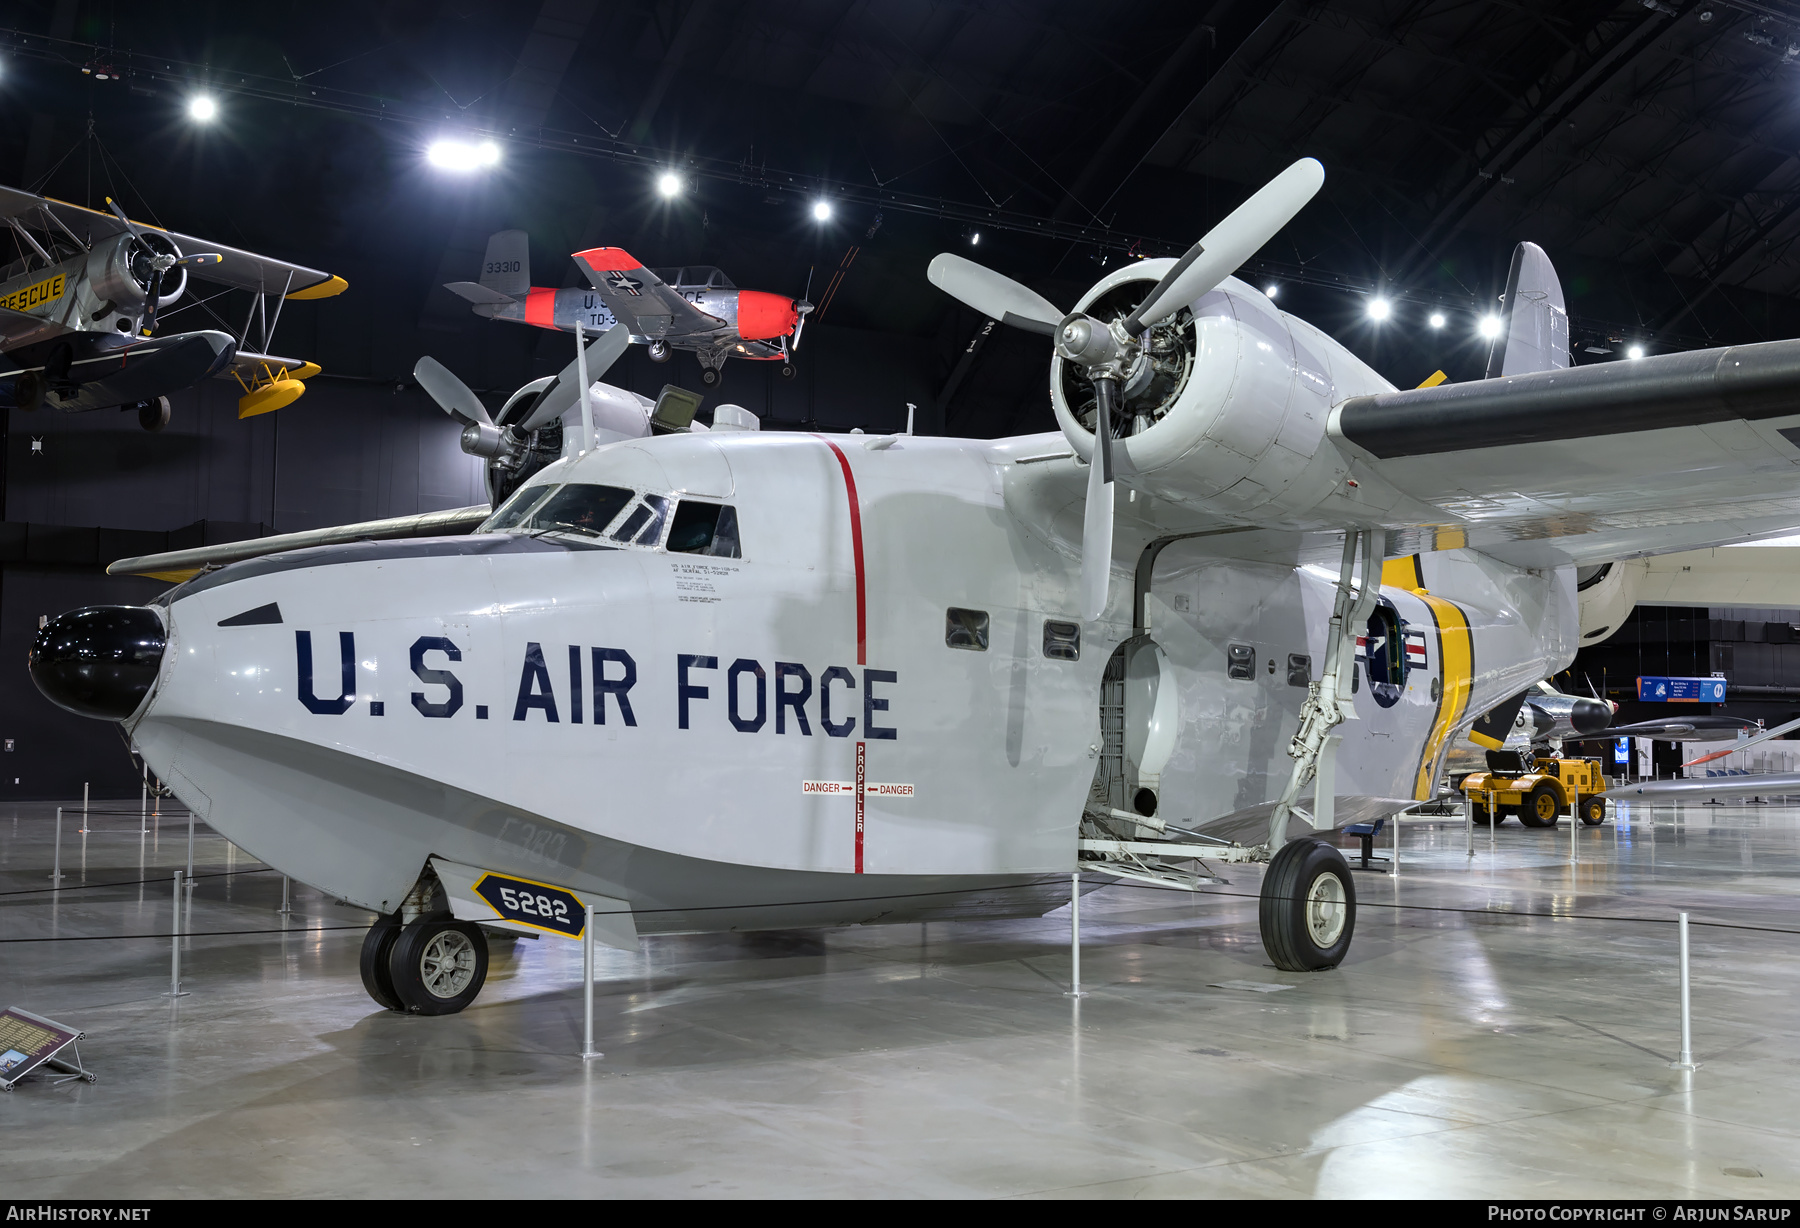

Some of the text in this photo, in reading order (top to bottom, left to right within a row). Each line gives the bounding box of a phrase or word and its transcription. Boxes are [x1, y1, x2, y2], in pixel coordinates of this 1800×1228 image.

[486, 261, 520, 273] 33310
[981, 326, 992, 335] 2
[295, 630, 898, 741] U.S. AIR FORCE
[803, 782, 840, 793] DANGER
[880, 785, 914, 795] DANGER
[499, 887, 571, 925] 5282
